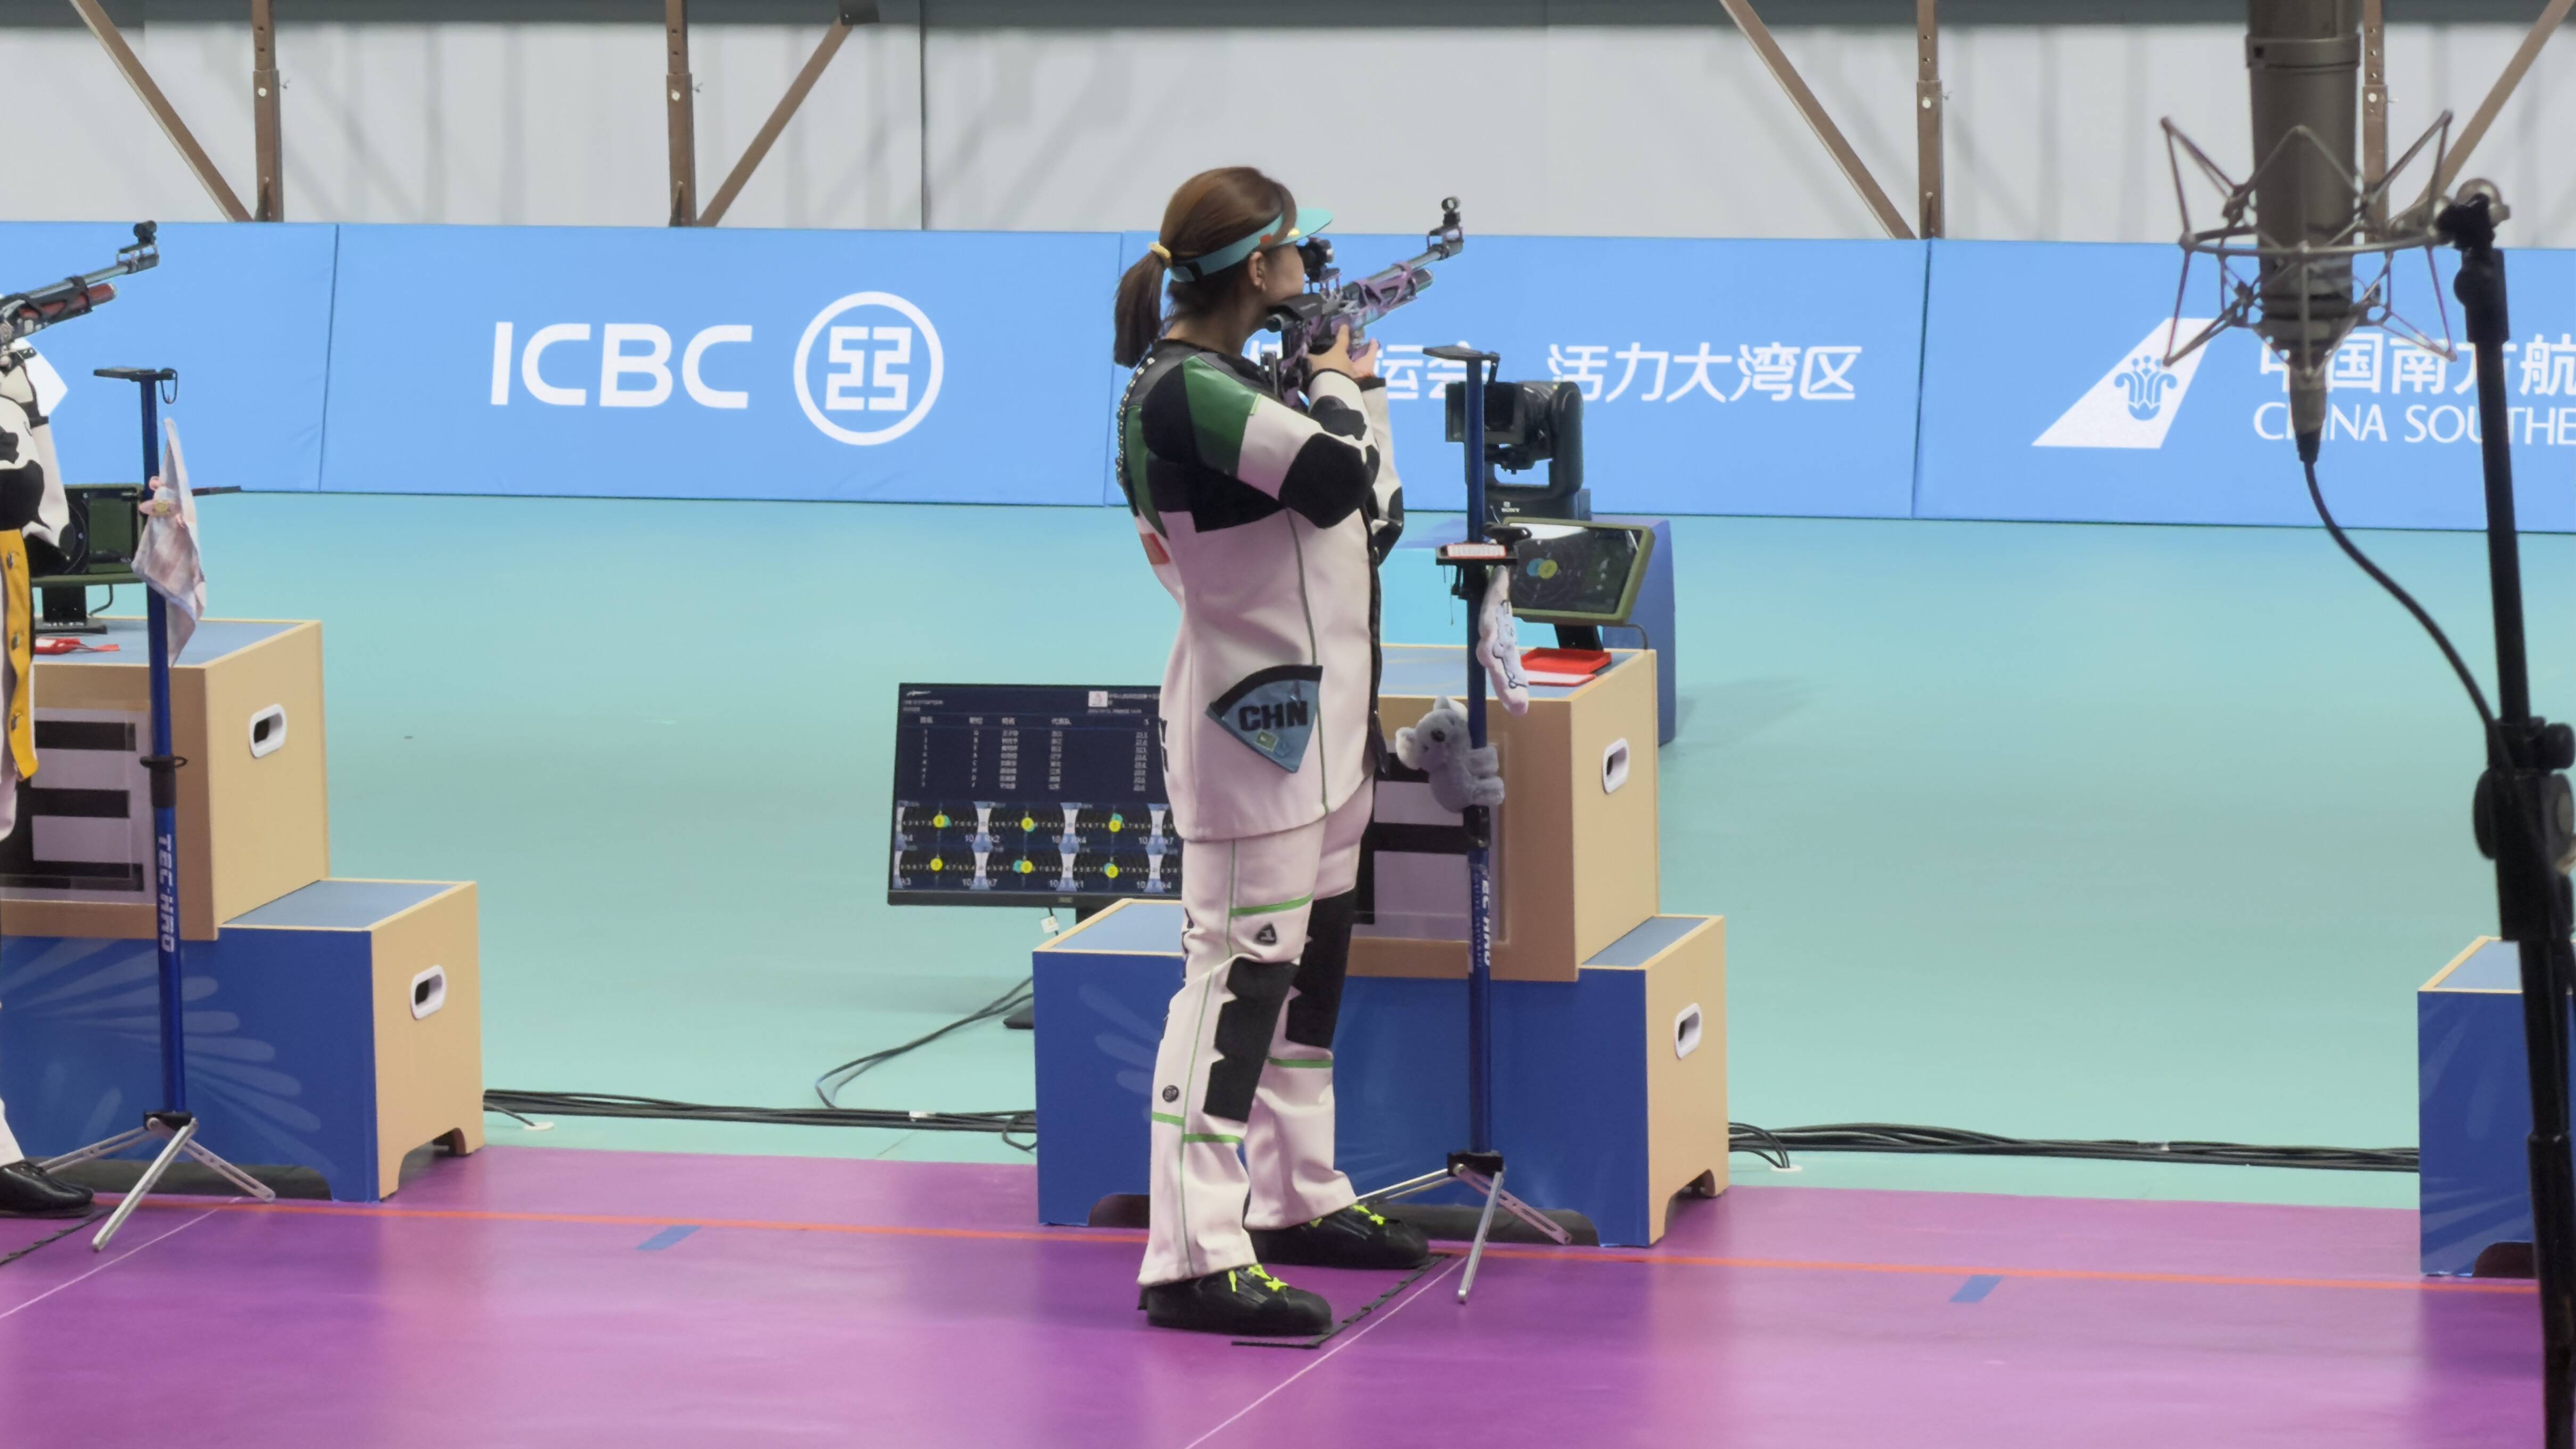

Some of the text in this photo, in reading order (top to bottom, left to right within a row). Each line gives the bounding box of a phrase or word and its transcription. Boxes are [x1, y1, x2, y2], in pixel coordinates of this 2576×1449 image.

[490, 322, 753, 409] ICBC
[1547, 341, 1863, 403] 活力大湾区
[2253, 401, 2389, 442] CNA
[1238, 700, 1308, 732] CHN
[0, 720, 144, 891] E
[158, 833, 175, 953] TEC-HRO
